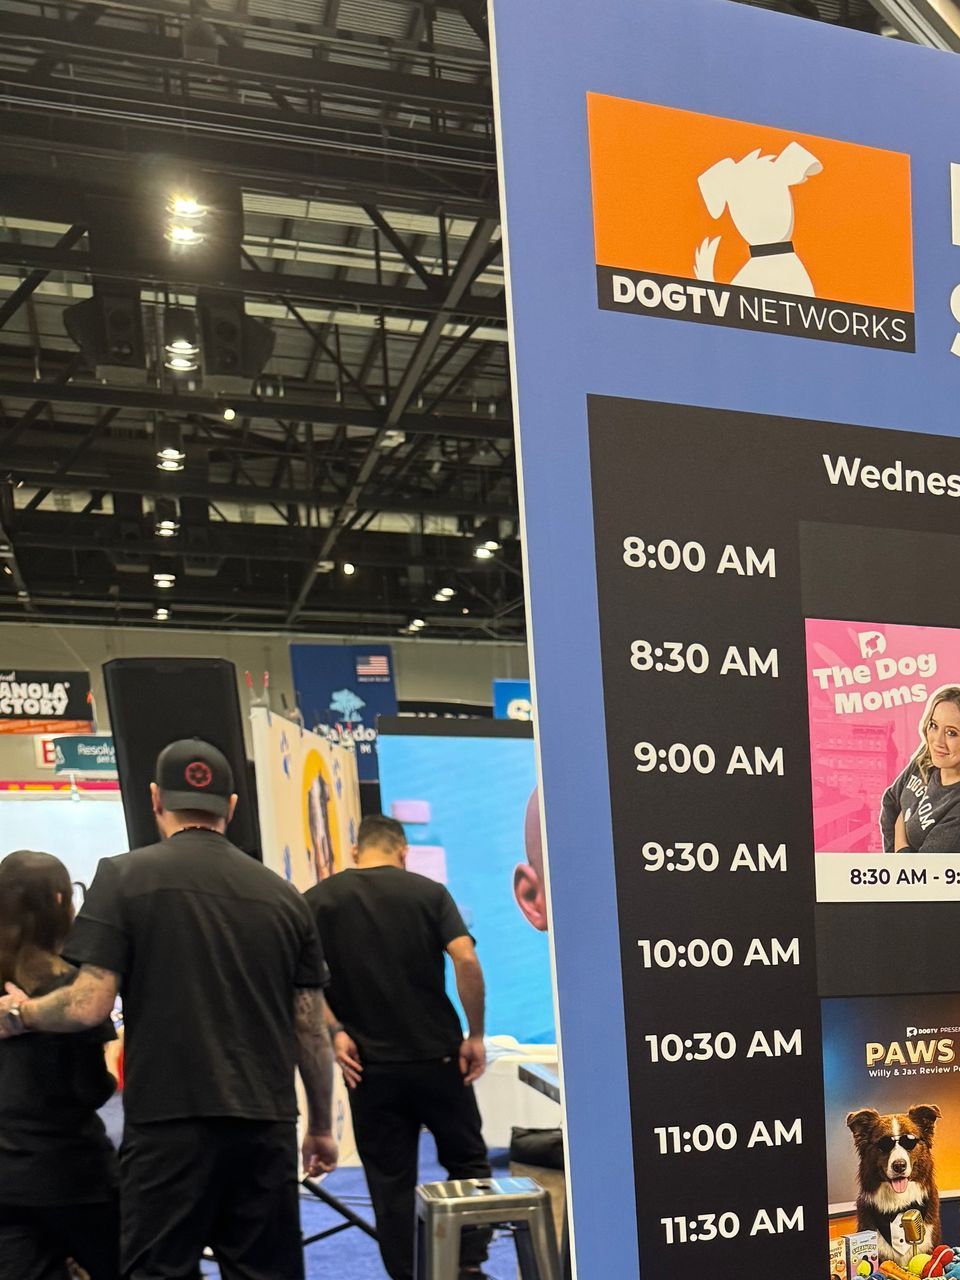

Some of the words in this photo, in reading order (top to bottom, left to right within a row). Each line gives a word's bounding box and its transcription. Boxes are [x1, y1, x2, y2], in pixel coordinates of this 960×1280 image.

[612, 274, 731, 317] DOGTV
[739, 294, 907, 342] NETWORKS
[623, 537, 705, 572] 8:00
[717, 545, 776, 577] AM
[631, 640, 709, 673] 8:30
[720, 646, 778, 677] AM
[813, 663, 871, 690] The
[875, 651, 937, 681] Dog
[0, 682, 68, 700] ANOLA
[834, 683, 928, 715] Moms
[634, 742, 715, 773] 9:00
[726, 746, 784, 775] AM
[642, 842, 719, 871] 9:30
[730, 844, 786, 871] AM
[850, 868, 891, 885] 8:30
[896, 868, 927, 885] AM
[638, 939, 733, 968] 10:00
[744, 938, 800, 965] AM
[645, 1032, 736, 1062] 10:30
[747, 1029, 801, 1057] AM
[866, 1038, 956, 1068] PAWS
[868, 1069, 891, 1078] Willy
[902, 1068, 917, 1076] Jax
[920, 1065, 951, 1074] Review
[654, 1123, 737, 1154] 11:00
[748, 1119, 803, 1147] AM
[661, 1211, 739, 1244] 11:30
[750, 1206, 805, 1236] AM
